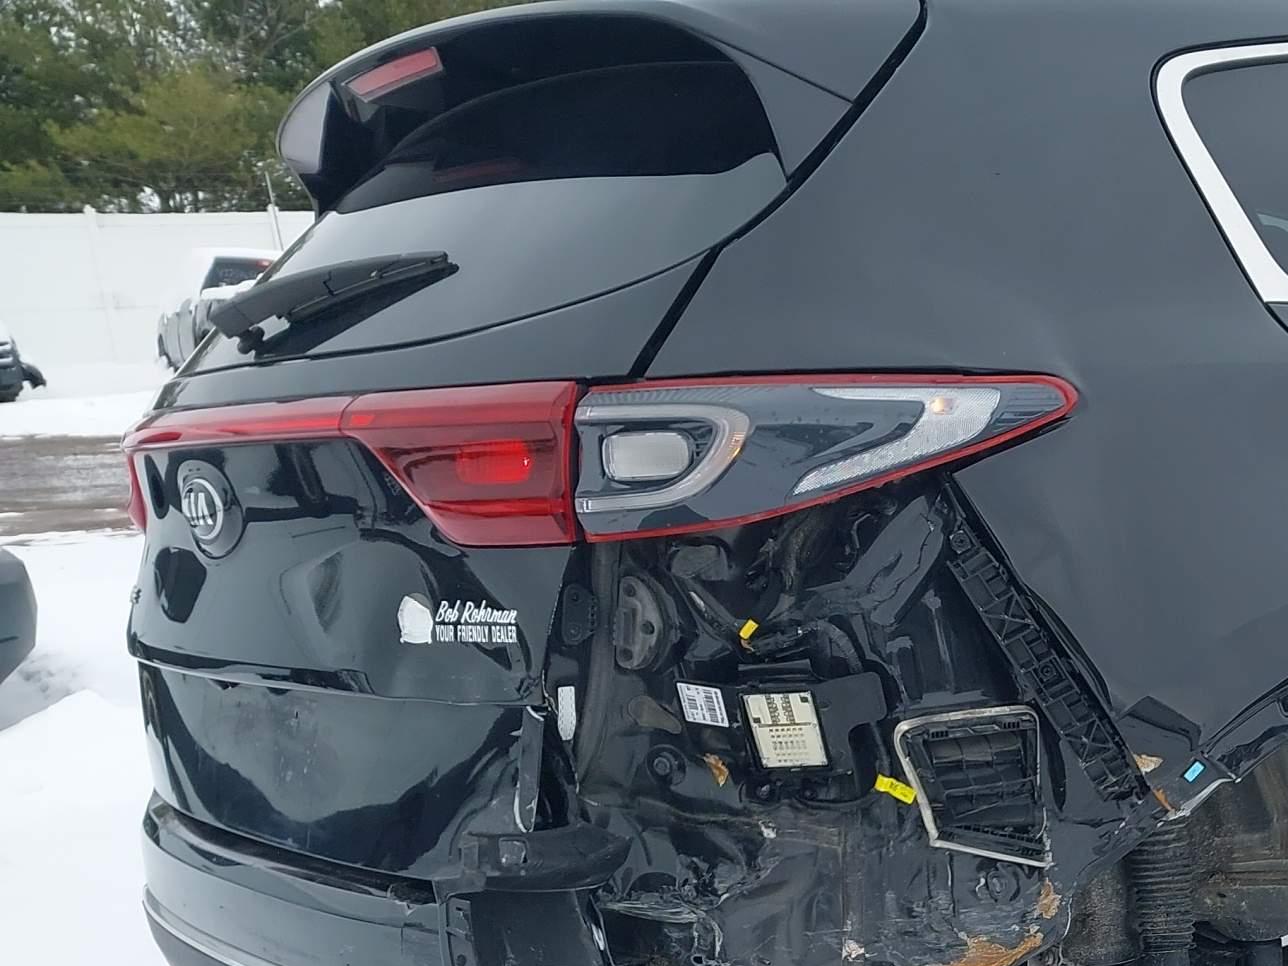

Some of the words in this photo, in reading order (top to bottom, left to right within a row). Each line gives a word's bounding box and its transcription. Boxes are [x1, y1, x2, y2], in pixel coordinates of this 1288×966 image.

[434, 600, 462, 623] Bob
[461, 600, 518, 624] Rohrman
[435, 625, 455, 643] YOUR
[457, 625, 489, 643] FRIENDLY
[491, 625, 518, 643] DEALER
